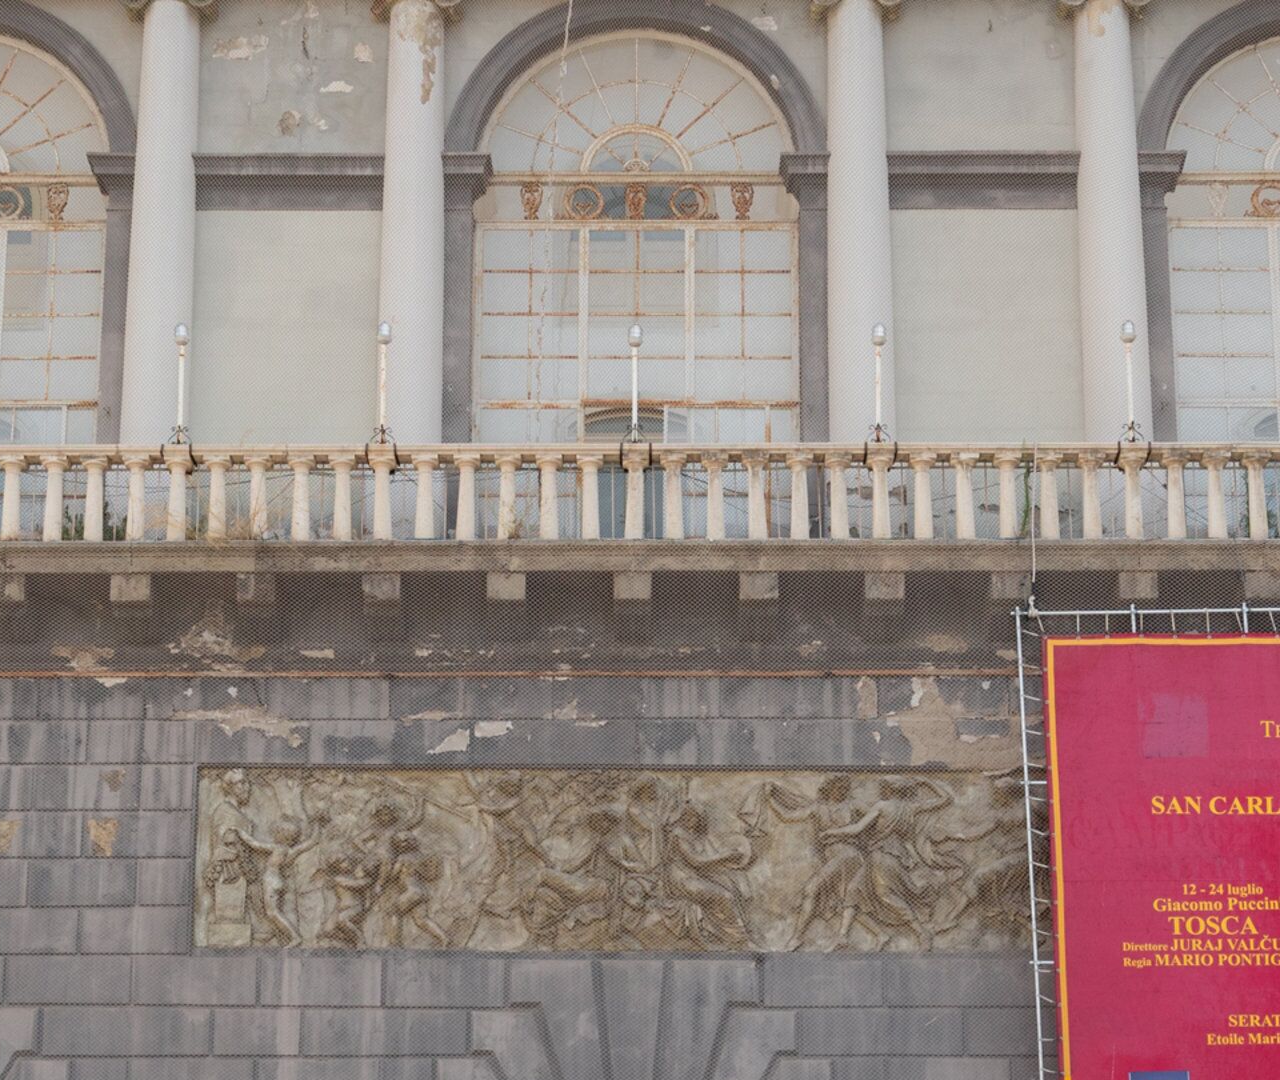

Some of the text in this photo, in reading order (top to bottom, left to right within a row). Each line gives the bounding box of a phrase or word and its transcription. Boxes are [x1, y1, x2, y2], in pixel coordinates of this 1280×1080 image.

[1151, 795, 1202, 815] SAN
[1182, 883, 1197, 896] 12
[1209, 883, 1224, 896] 24
[1227, 883, 1264, 898] luglio
[1152, 898, 1223, 912] Giacomo
[1167, 915, 1259, 936] TOSCA
[1122, 942, 1168, 952] Direttore
[1170, 938, 1223, 952] JURAJ
[1123, 957, 1152, 969] Regia
[1155, 953, 1214, 967] MARIO
[1207, 1033, 1245, 1045] Etoile
